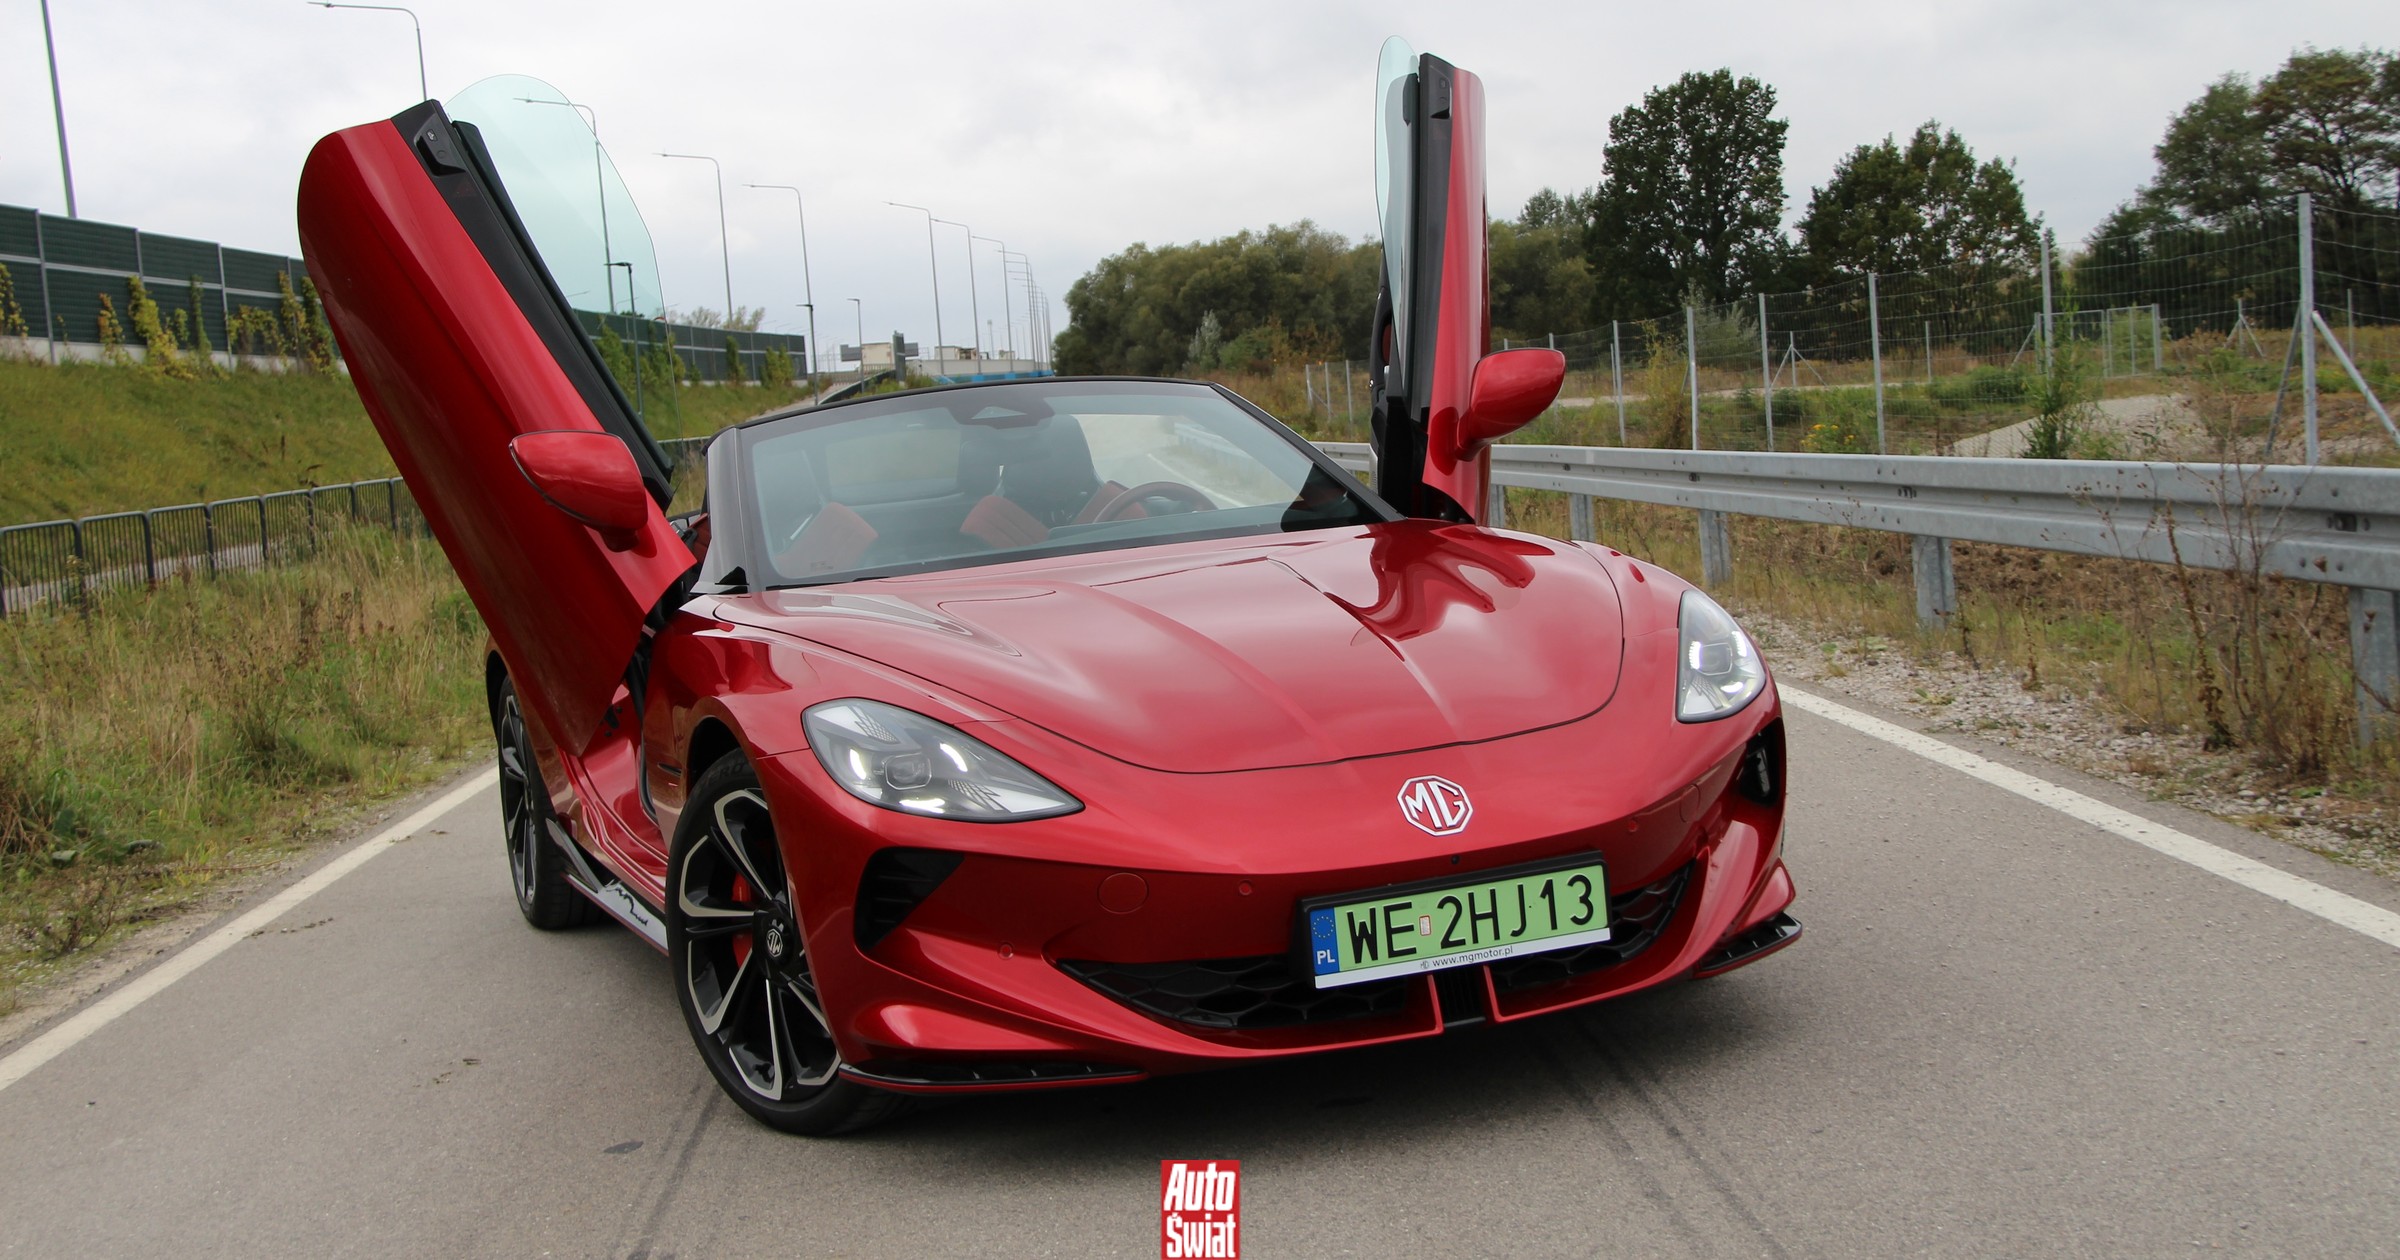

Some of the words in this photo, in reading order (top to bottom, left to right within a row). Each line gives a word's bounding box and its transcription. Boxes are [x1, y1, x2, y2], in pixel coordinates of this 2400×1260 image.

[1404, 781, 1466, 828] MG
[1346, 901, 1417, 964] WE
[1436, 874, 1594, 949] 2HJ13
[1316, 949, 1336, 965] PL
[1432, 945, 1514, 968] www.mgmotor.pl
